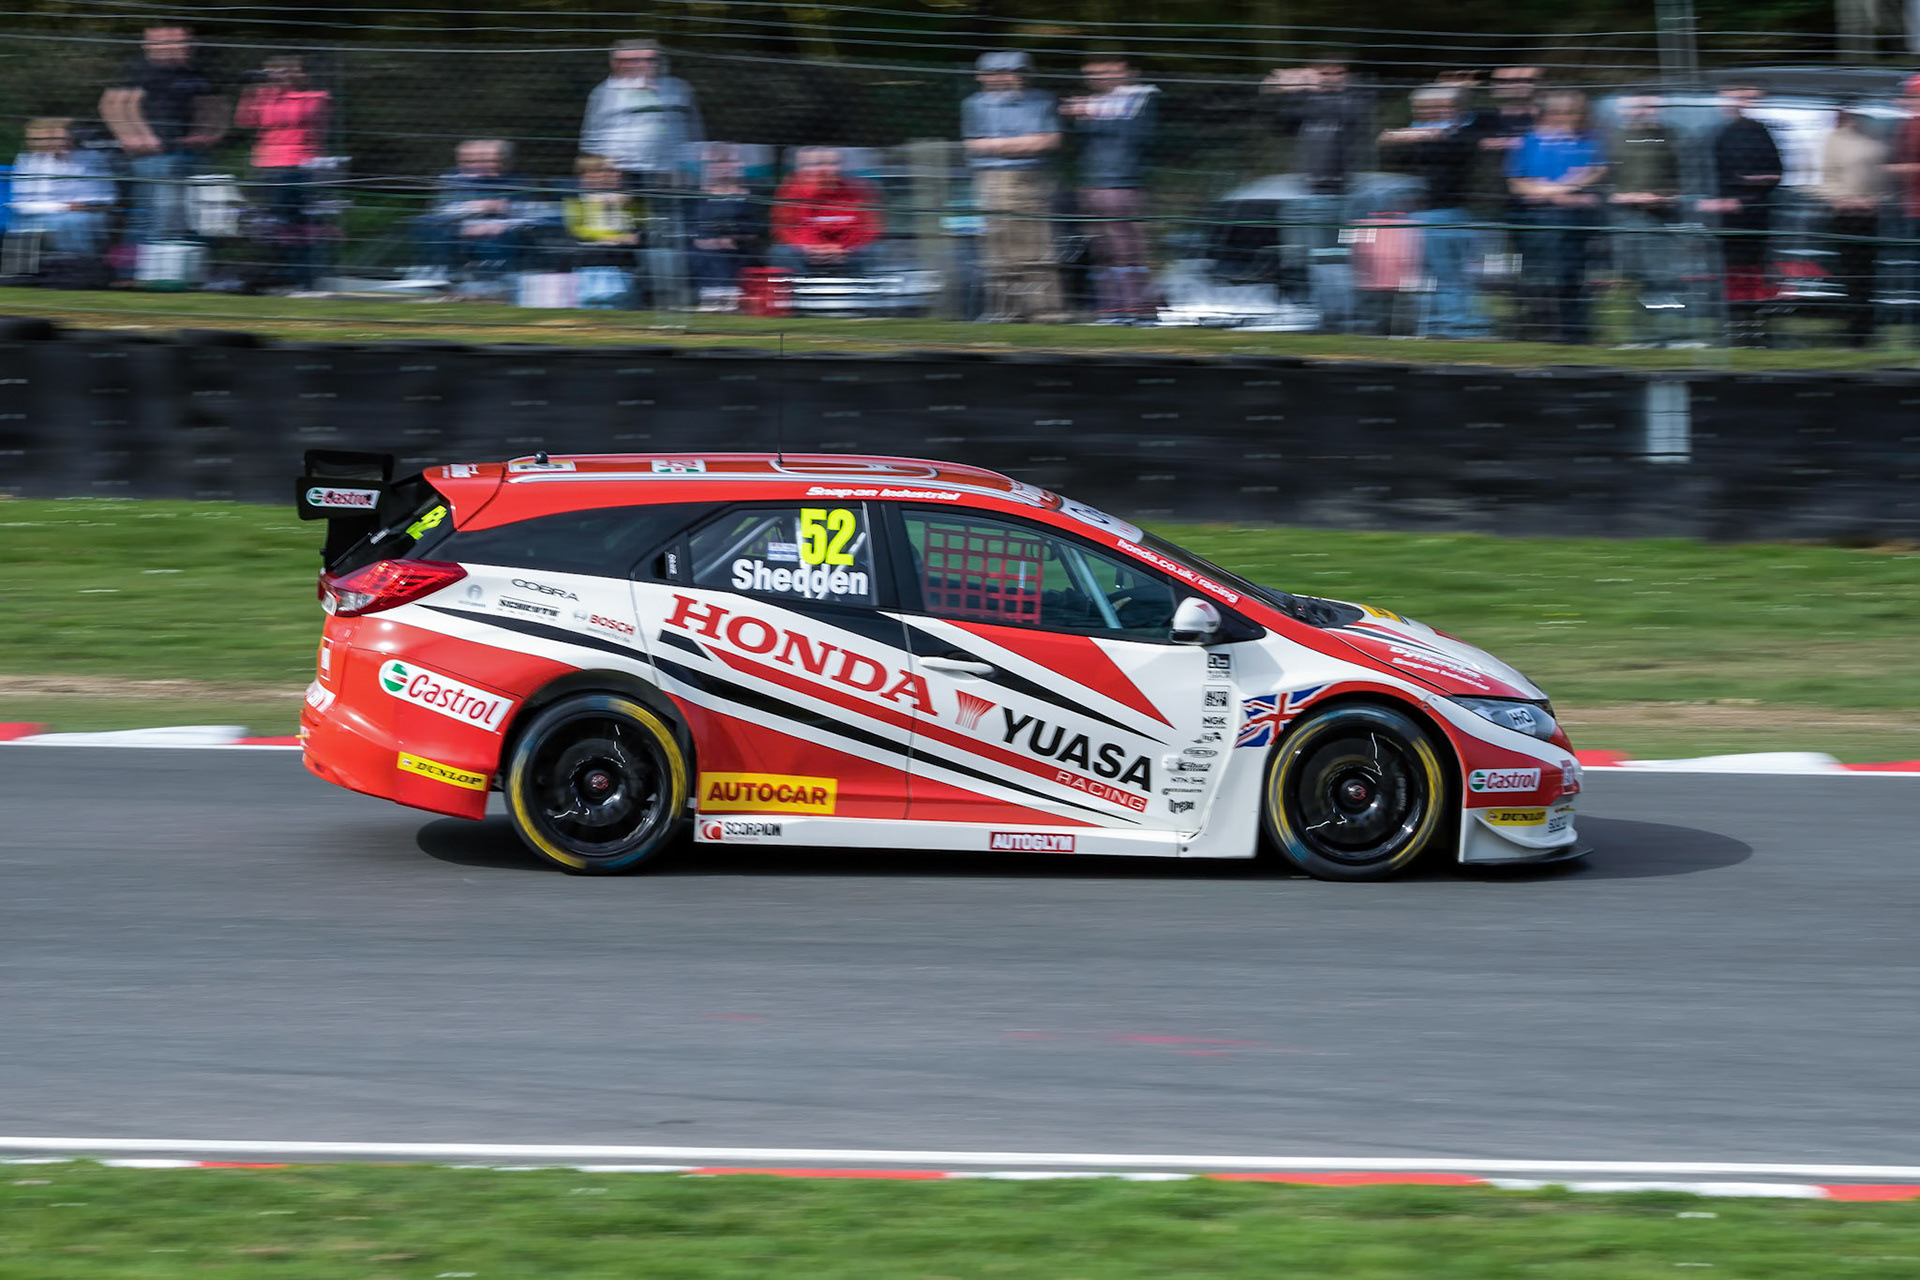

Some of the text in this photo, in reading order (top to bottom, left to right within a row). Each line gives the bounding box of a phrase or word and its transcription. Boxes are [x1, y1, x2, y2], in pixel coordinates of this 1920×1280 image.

[324, 489, 373, 506] Castrol
[879, 489, 962, 501] Industrial
[800, 507, 857, 567] 52
[731, 558, 869, 596] Shedden
[511, 578, 581, 602] COBRA
[589, 614, 636, 636] BOSCH
[664, 593, 940, 717] HONDA
[407, 674, 500, 725] Castrol
[1202, 715, 1227, 726] NGK
[1001, 706, 1152, 793] YUASA
[416, 761, 483, 785] DUNLOP
[1486, 772, 1537, 789] Castrol
[707, 781, 829, 806] AUTOCAR
[1055, 770, 1147, 812] RACING
[1499, 811, 1546, 822] DUNLOP
[725, 821, 783, 837] SCORPION
[991, 834, 1075, 852] AUTOGLYM
